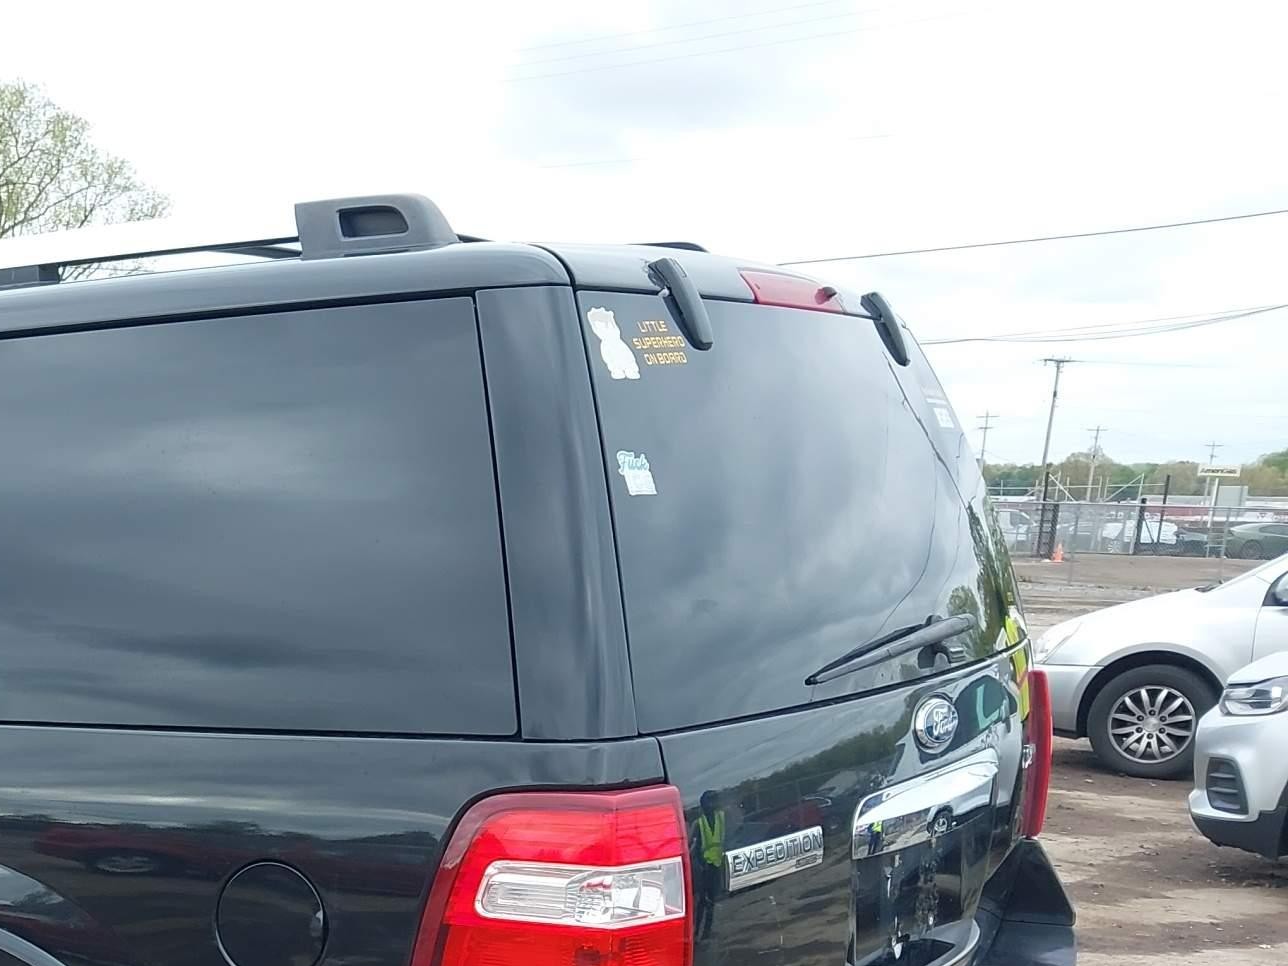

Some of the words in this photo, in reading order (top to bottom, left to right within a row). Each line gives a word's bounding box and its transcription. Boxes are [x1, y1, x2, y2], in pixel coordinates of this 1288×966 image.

[637, 320, 668, 333] LITTLE
[632, 335, 686, 349] SUPERHERO
[643, 352, 658, 366] ON
[656, 351, 688, 364] BOARD
[731, 829, 824, 875] EXPEDITION
